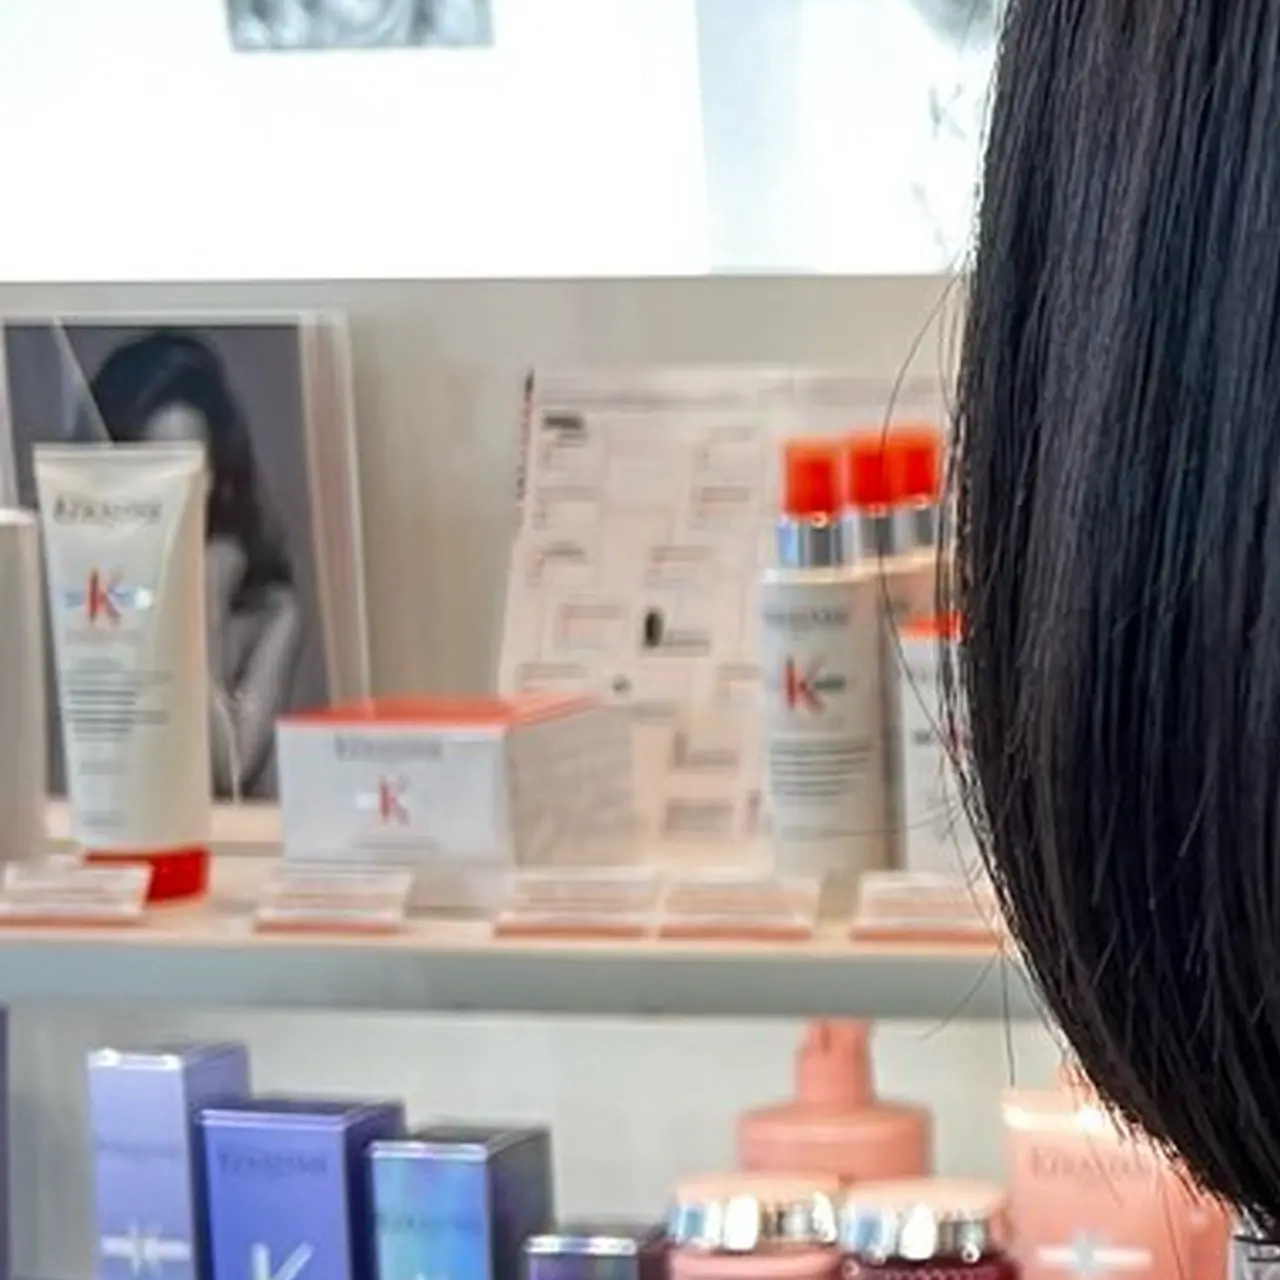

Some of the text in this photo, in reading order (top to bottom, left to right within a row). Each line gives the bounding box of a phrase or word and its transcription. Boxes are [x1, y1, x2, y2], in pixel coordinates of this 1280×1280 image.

[86, 566, 123, 626] K
[782, 655, 826, 714] K
[378, 773, 411, 827] K
